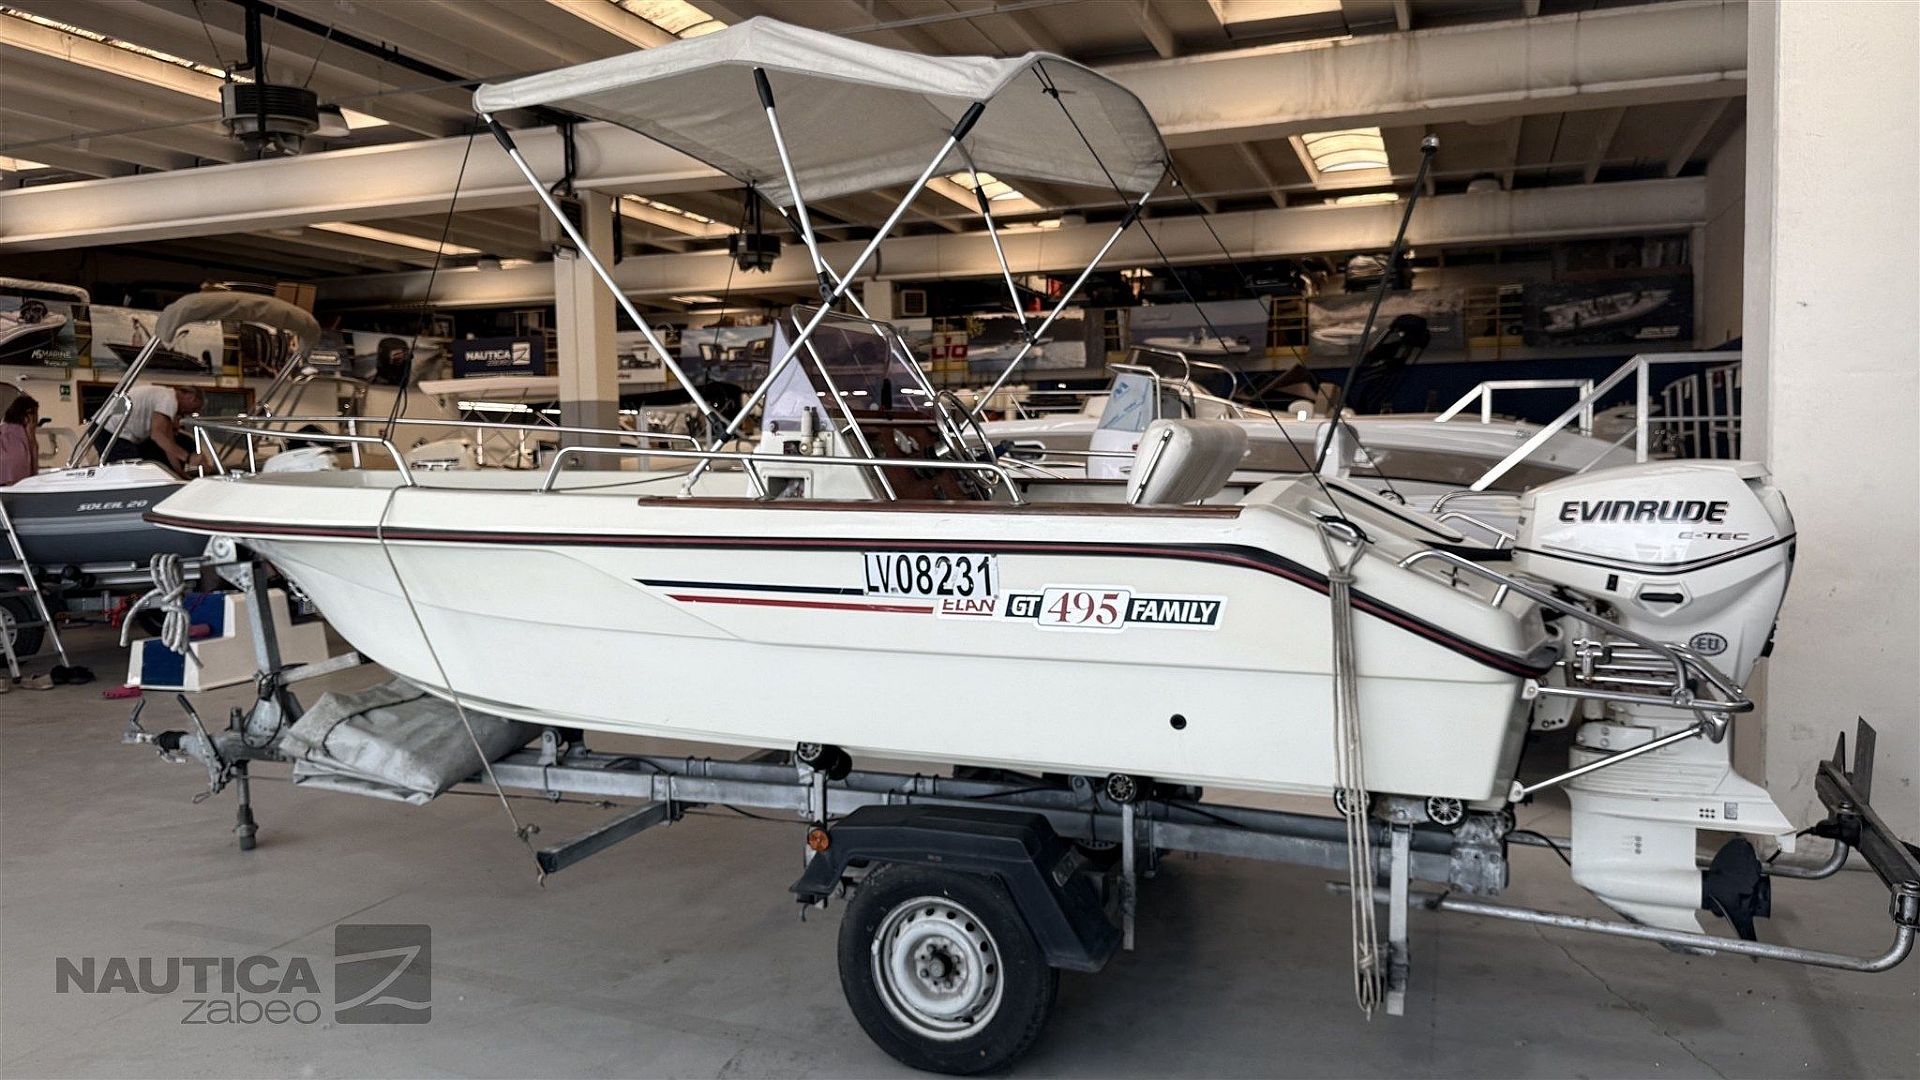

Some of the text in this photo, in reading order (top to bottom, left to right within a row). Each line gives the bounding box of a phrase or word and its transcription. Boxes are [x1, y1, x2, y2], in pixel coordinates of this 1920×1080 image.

[465, 350, 511, 361] NAUTICA
[77, 499, 148, 512] SOLEIL 20
[1558, 500, 1729, 525] EVINRUDE
[1011, 596, 1041, 617] GT
[1047, 592, 1120, 625] 495
[1130, 600, 1217, 624] FAMILY
[1696, 637, 1719, 651] EU
